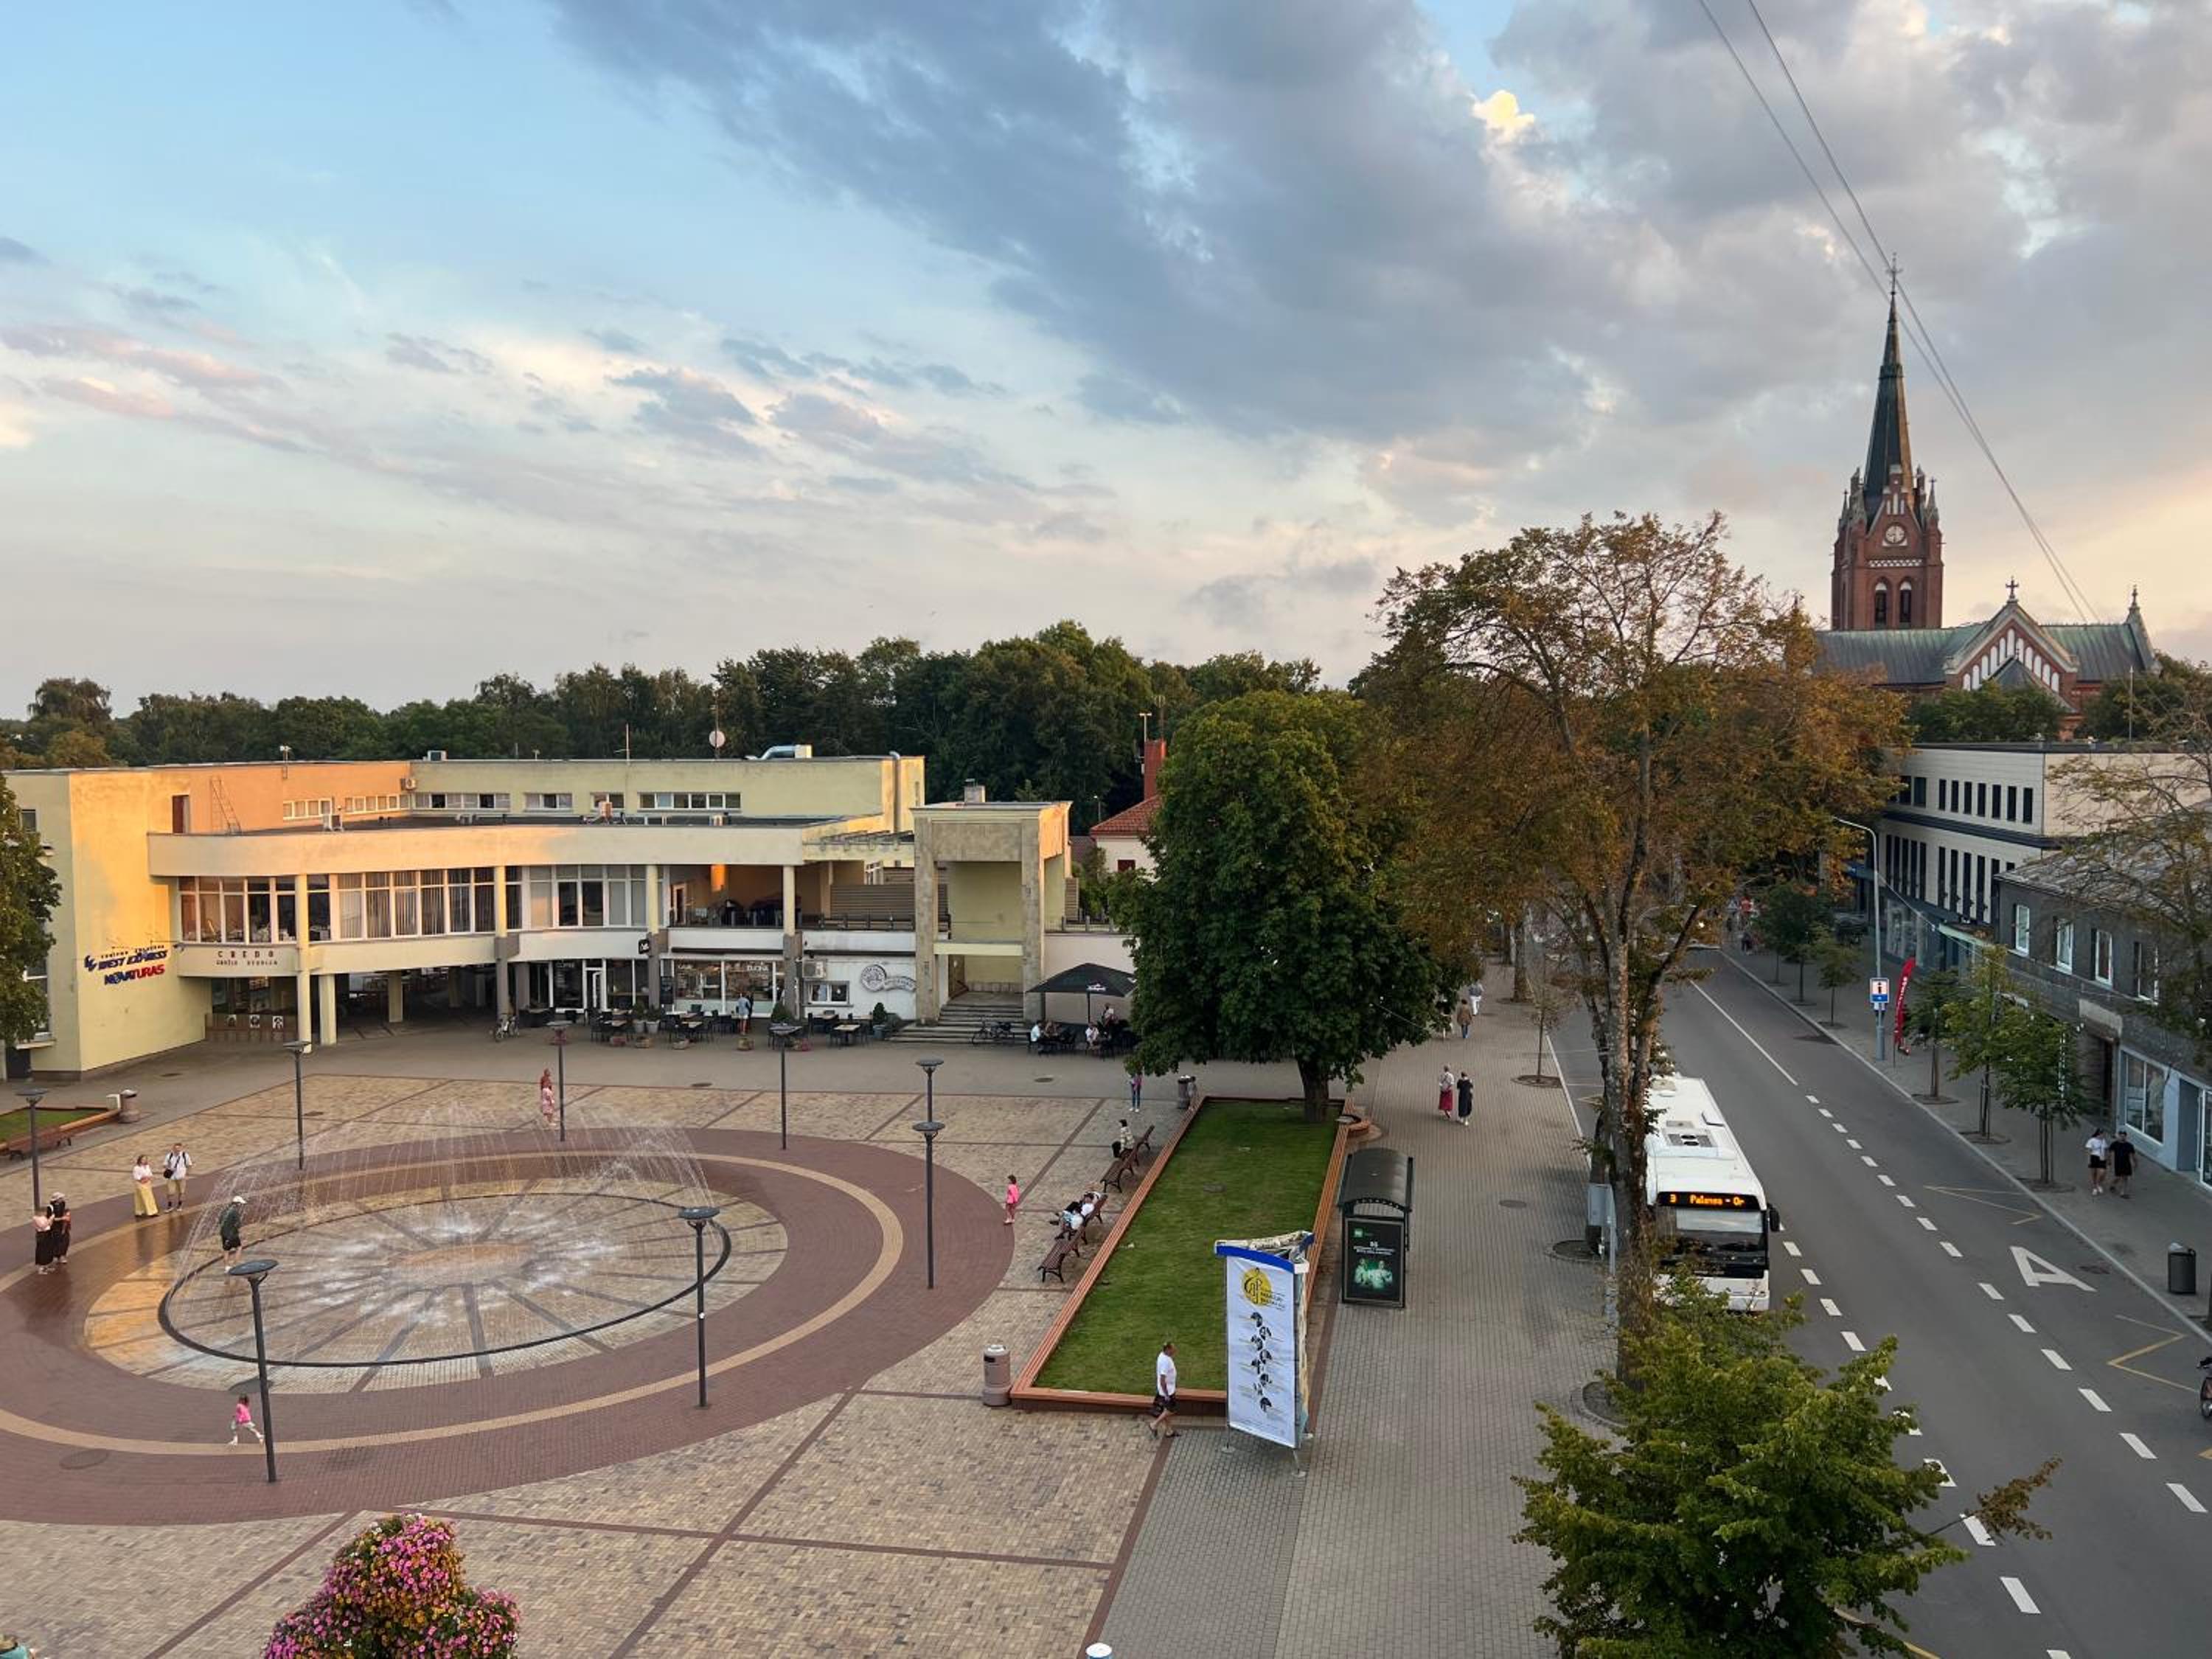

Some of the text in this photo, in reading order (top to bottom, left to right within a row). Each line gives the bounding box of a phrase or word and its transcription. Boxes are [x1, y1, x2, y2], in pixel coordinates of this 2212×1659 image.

[217, 950, 274, 959] CREDO
[98, 958, 125, 970] WEST
[104, 964, 166, 985] NOVATURAS
[1669, 1194, 1677, 1203] 3
[2009, 1245, 2098, 1292] A
